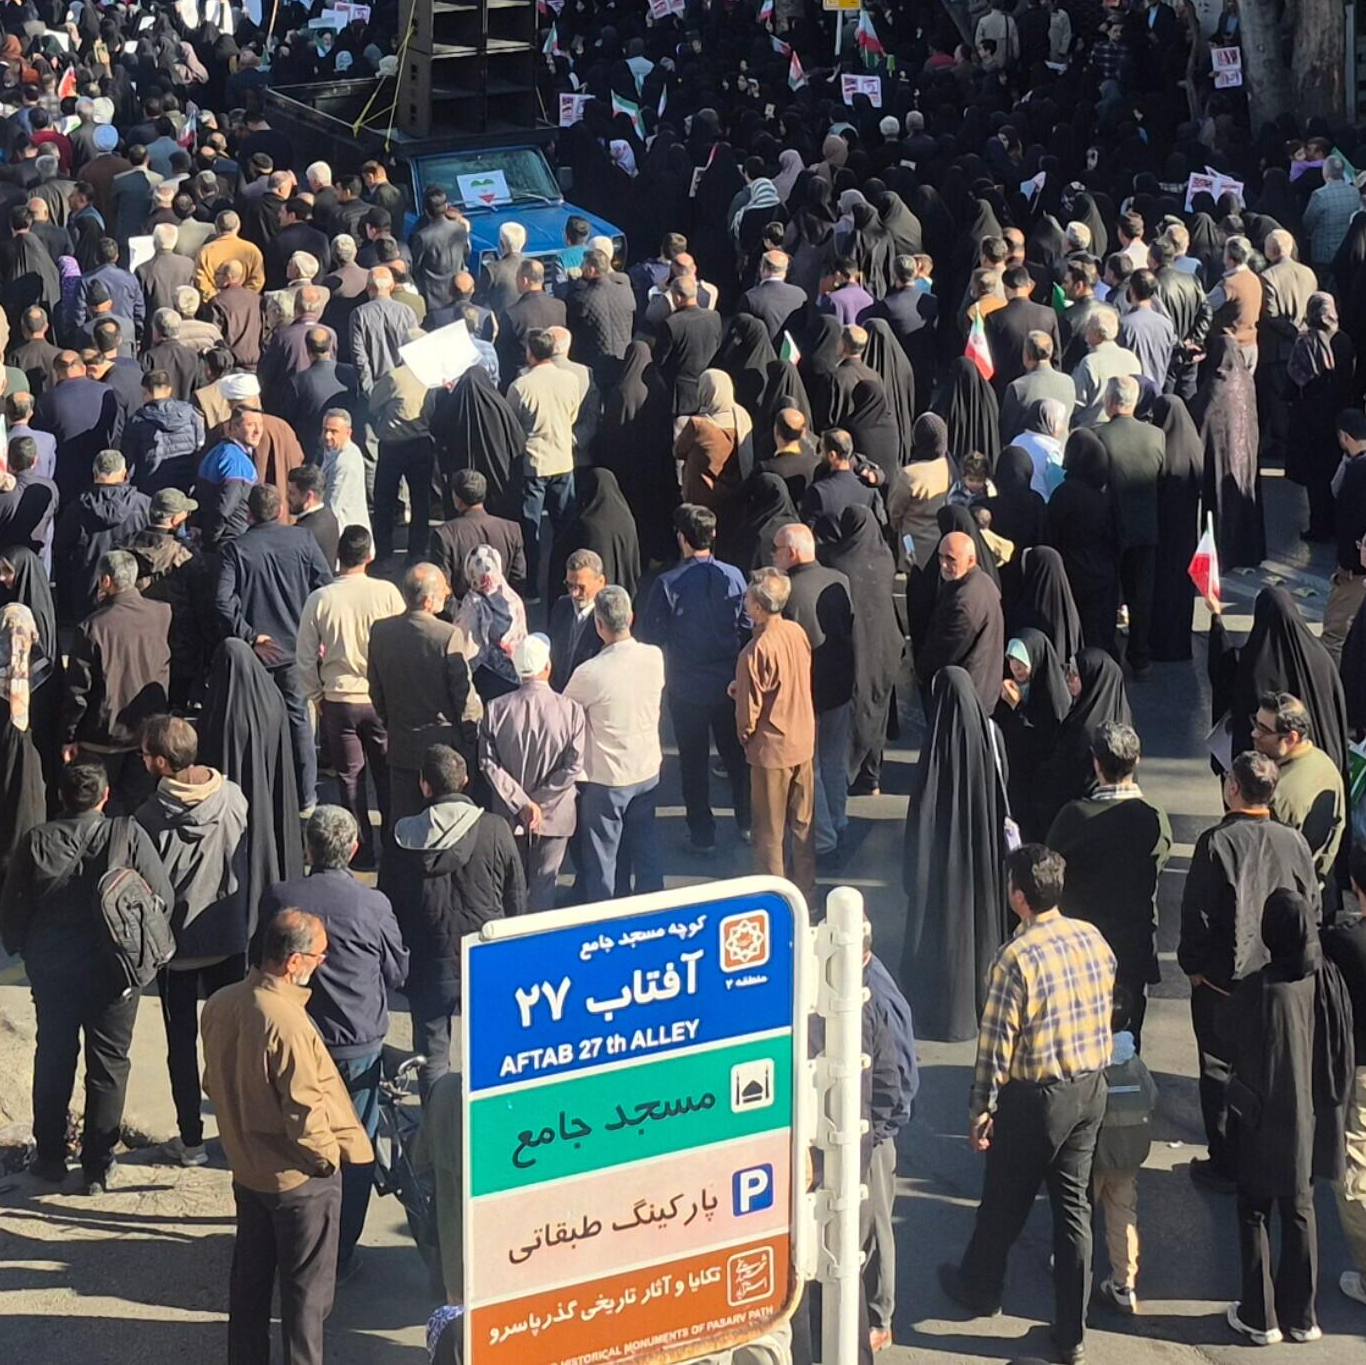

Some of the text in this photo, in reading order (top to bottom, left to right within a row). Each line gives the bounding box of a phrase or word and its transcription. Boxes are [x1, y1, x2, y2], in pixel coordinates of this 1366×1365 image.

[579, 915, 707, 960] کوچه مسجد جامع
[514, 949, 704, 1027] آفتاب ۲۷
[735, 975, 768, 986] منطقه
[499, 1019, 700, 1077] AFTAB 27 th ALLEY
[511, 1091, 716, 1169] مسجد جامع
[739, 1169, 769, 1212] P
[508, 1188, 718, 1264] پارکینگ طبقاتی
[641, 1275, 672, 1305] آثار
[675, 1280, 685, 1296] و
[688, 1266, 722, 1293] تکایا
[580, 1287, 637, 1322] تاریخی
[623, 1328, 689, 1355] MONUMENTS
[691, 1323, 704, 1336] OF
[748, 1305, 774, 1321] PATH
